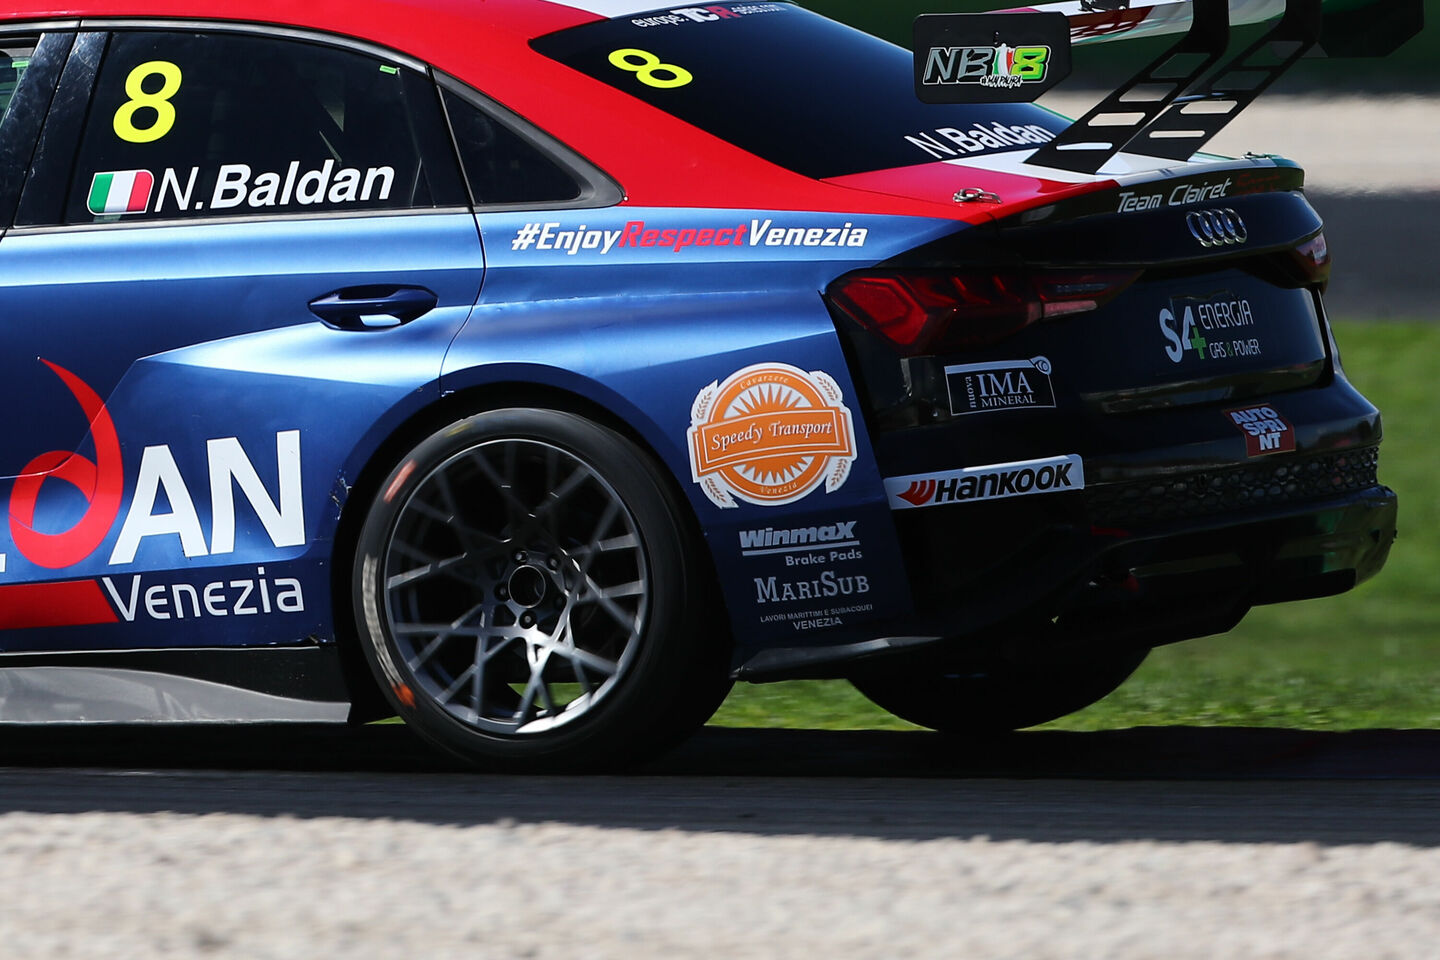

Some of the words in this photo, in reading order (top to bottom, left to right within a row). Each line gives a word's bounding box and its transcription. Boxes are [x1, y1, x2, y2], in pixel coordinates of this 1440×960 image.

[608, 48, 693, 89] 8
[113, 60, 182, 143] 8
[1116, 191, 1163, 214] Team
[1168, 177, 1233, 206] Clairet
[975, 371, 1035, 397] IMA
[981, 394, 1036, 409] MINERAL
[1230, 407, 1279, 425] AUTO
[711, 422, 763, 451] Speedy
[767, 420, 833, 439] Transport
[785, 553, 826, 567] Brake
[829, 549, 863, 562] Pads
[100, 567, 305, 622] Venezia
[760, 613, 787, 623] LAVORI
[792, 617, 843, 631] VENEZIA
